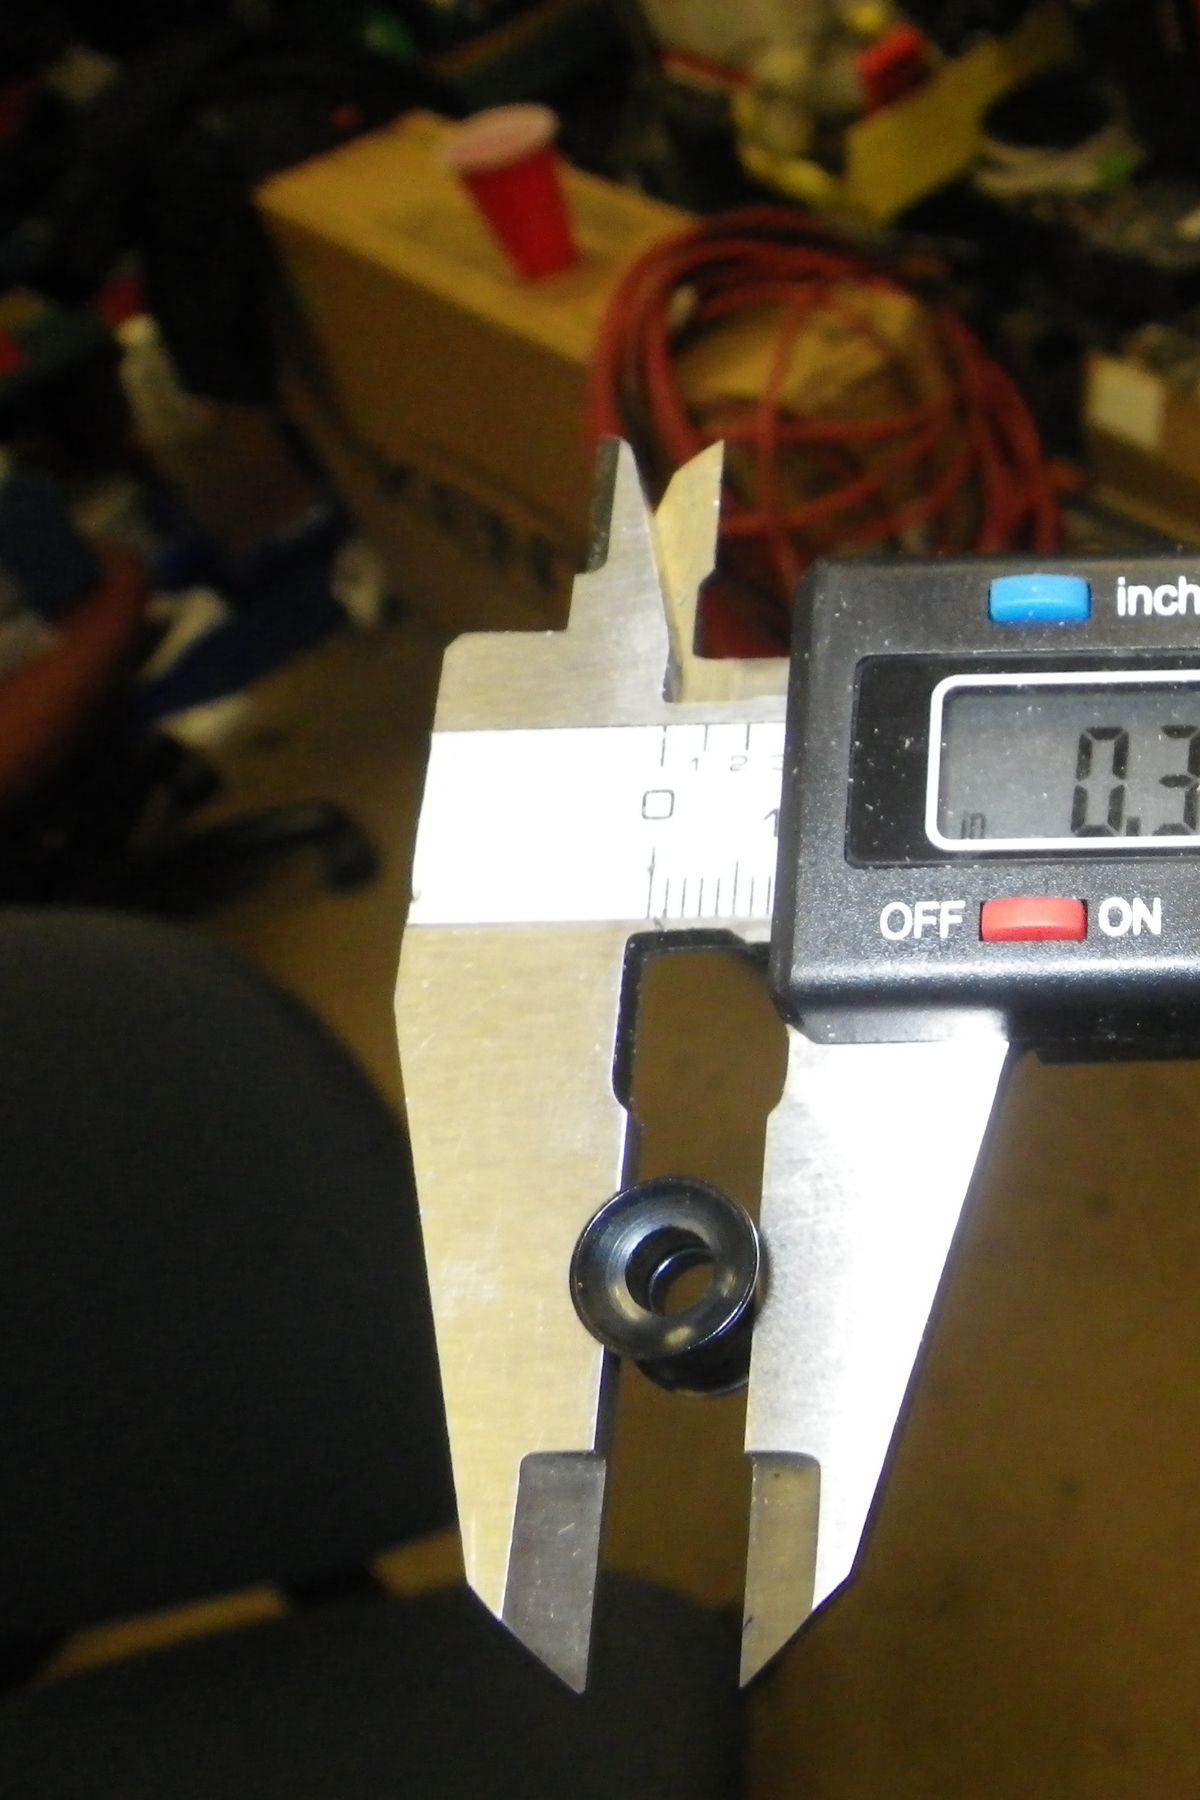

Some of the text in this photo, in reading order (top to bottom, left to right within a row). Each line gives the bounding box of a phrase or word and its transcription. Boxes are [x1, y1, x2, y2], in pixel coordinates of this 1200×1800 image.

[691, 757, 699, 772] 1
[730, 755, 748, 772] 2
[641, 789, 675, 820] 0
[880, 898, 1162, 940] OFF ON
